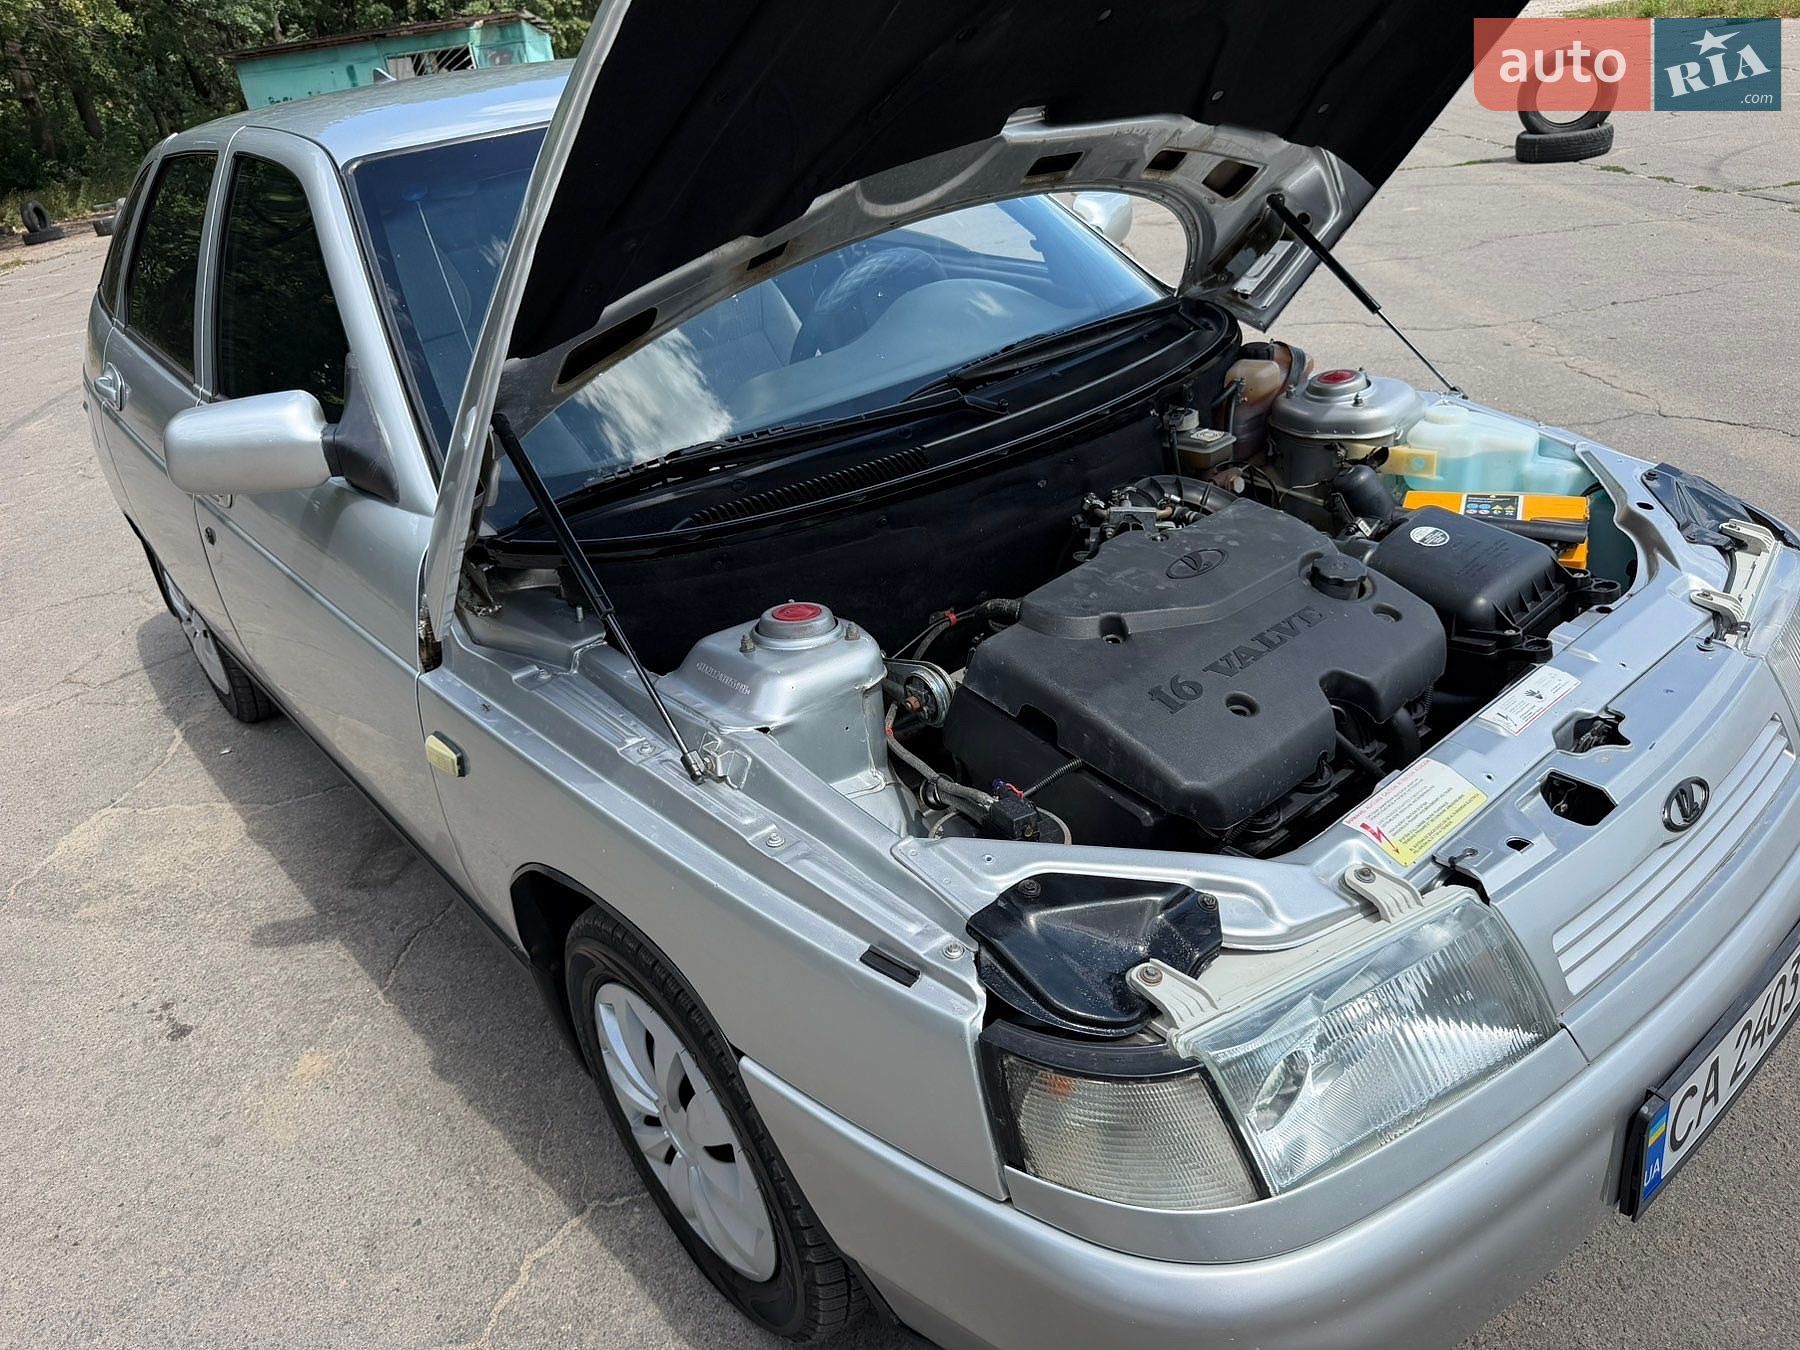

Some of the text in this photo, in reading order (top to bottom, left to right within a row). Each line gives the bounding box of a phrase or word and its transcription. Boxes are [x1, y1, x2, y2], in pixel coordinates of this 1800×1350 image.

[1148, 605, 1328, 715] 16 VALVE
[1669, 1056, 1721, 1152] CA
[1643, 1163, 1661, 1187] UA
